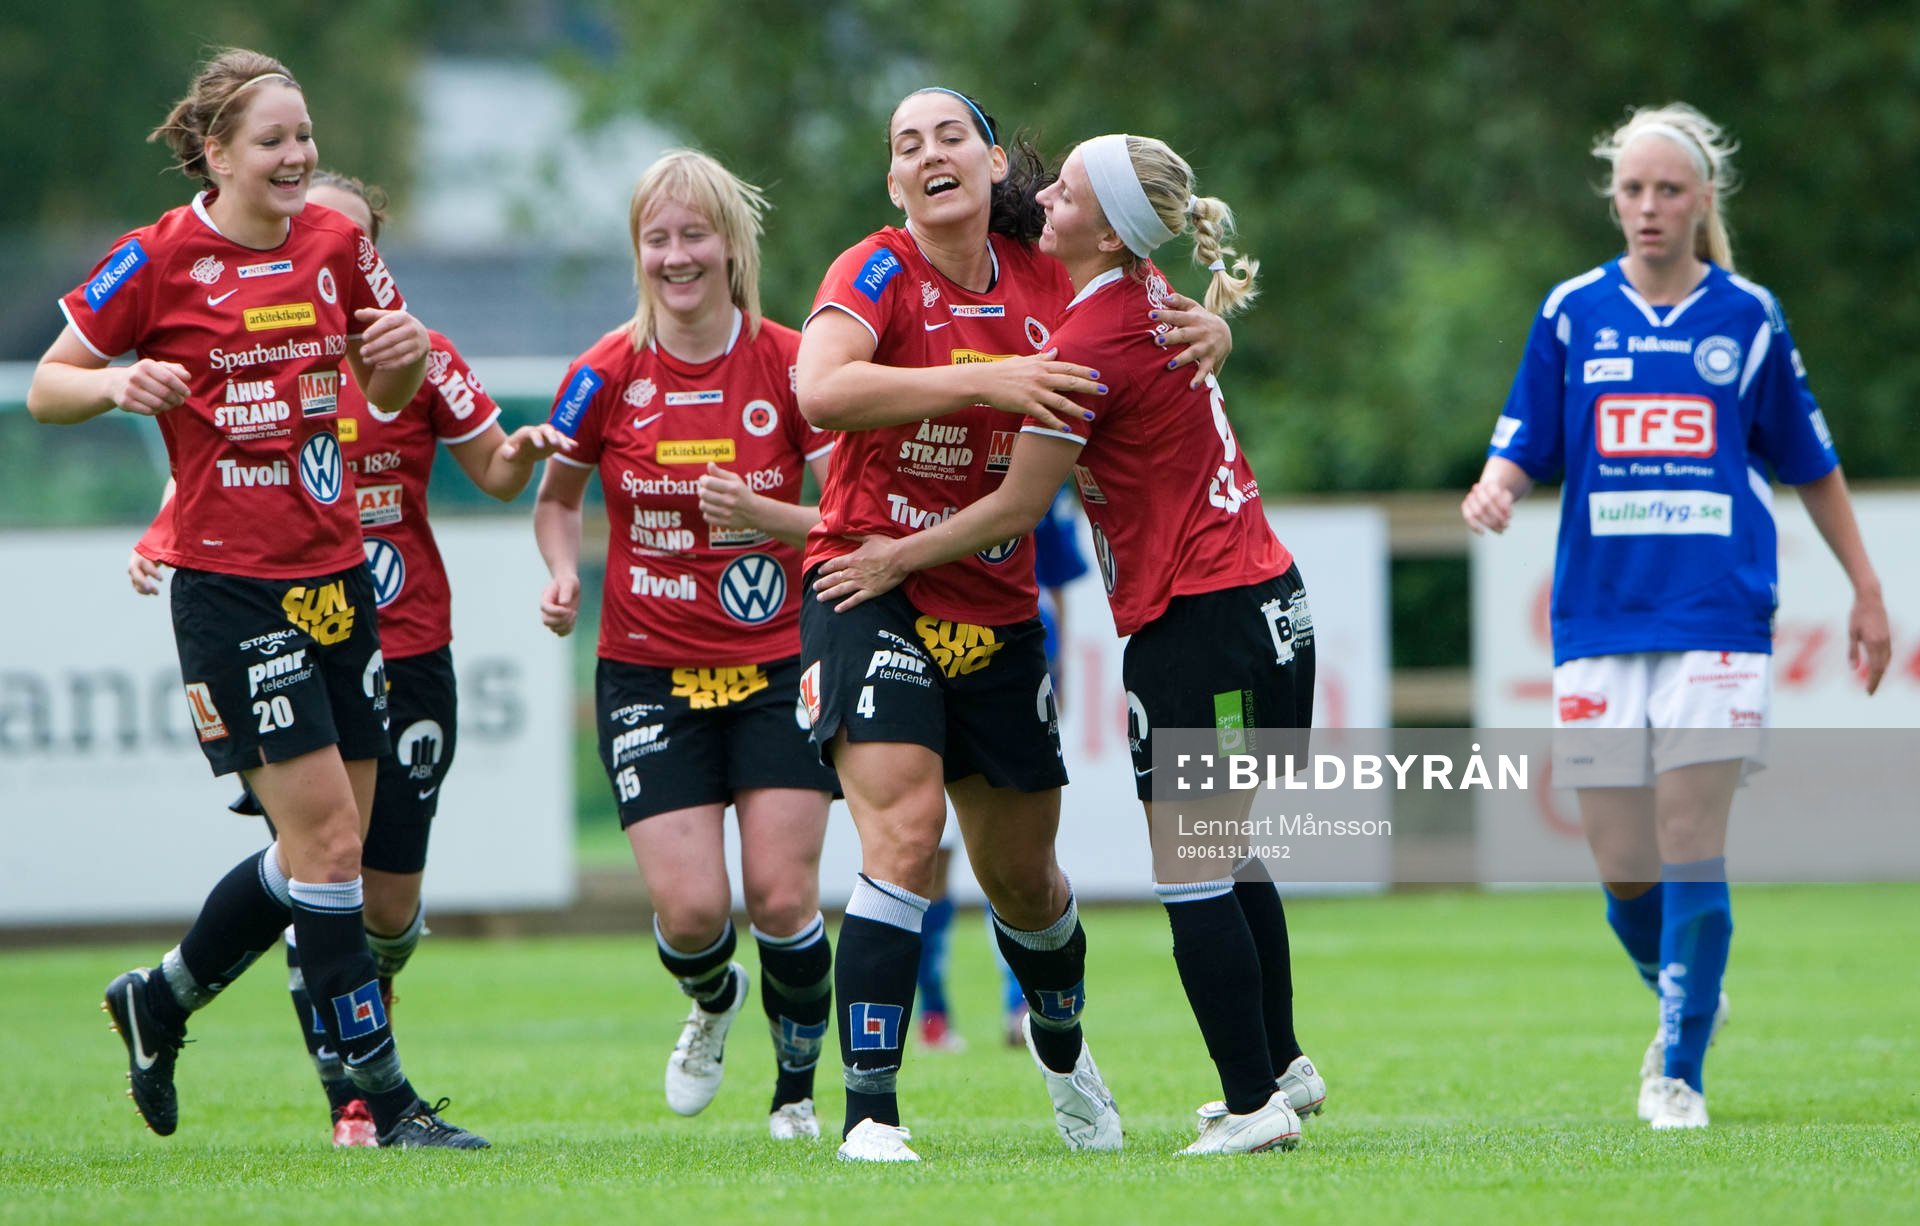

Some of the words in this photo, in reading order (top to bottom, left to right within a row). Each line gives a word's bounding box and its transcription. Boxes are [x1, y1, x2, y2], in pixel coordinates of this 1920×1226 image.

[91, 246, 139, 300] Folksam
[249, 262, 291, 275] INTERSPORT
[249, 308, 311, 325] arkitektkopia
[958, 306, 1004, 315] INTERSPORT
[209, 339, 322, 374] Sparbanken
[324, 334, 347, 357] 1826
[225, 378, 276, 404] ÅHUS
[300, 375, 337, 401] MAXI
[559, 374, 595, 427] Folksam
[214, 400, 291, 427] STRAND
[1607, 407, 1706, 445] TFS
[914, 418, 969, 445] ÅHUS
[363, 449, 402, 475] 1826
[661, 444, 731, 457] arkitektkopia
[899, 440, 974, 467] STRAND
[216, 459, 290, 488] Tivoli
[903, 467, 944, 480] CONFERENCE
[912, 462, 937, 472] SEASIDE
[621, 469, 700, 498] Sparban
[745, 465, 784, 492] 1826
[359, 489, 402, 511] AXI
[887, 493, 958, 530] Tivol
[1598, 499, 1723, 523] kullaflyg.se
[633, 504, 682, 529] ÅHUS
[629, 524, 695, 551] STRAND
[629, 565, 697, 601] Tivoli
[281, 580, 350, 623] SUN
[239, 628, 299, 651] STARKA
[915, 615, 996, 657] SUN
[248, 649, 306, 698] pmr
[865, 650, 927, 679] pmr
[261, 667, 314, 693] telecenter
[879, 668, 934, 689] telecenter
[252, 695, 295, 735] 20
[373, 697, 388, 711] AB
[610, 703, 665, 721] STARKA
[856, 685, 876, 720] 4
[1048, 721, 1059, 736] AB
[612, 723, 665, 770] pmr
[616, 765, 642, 803] 15
